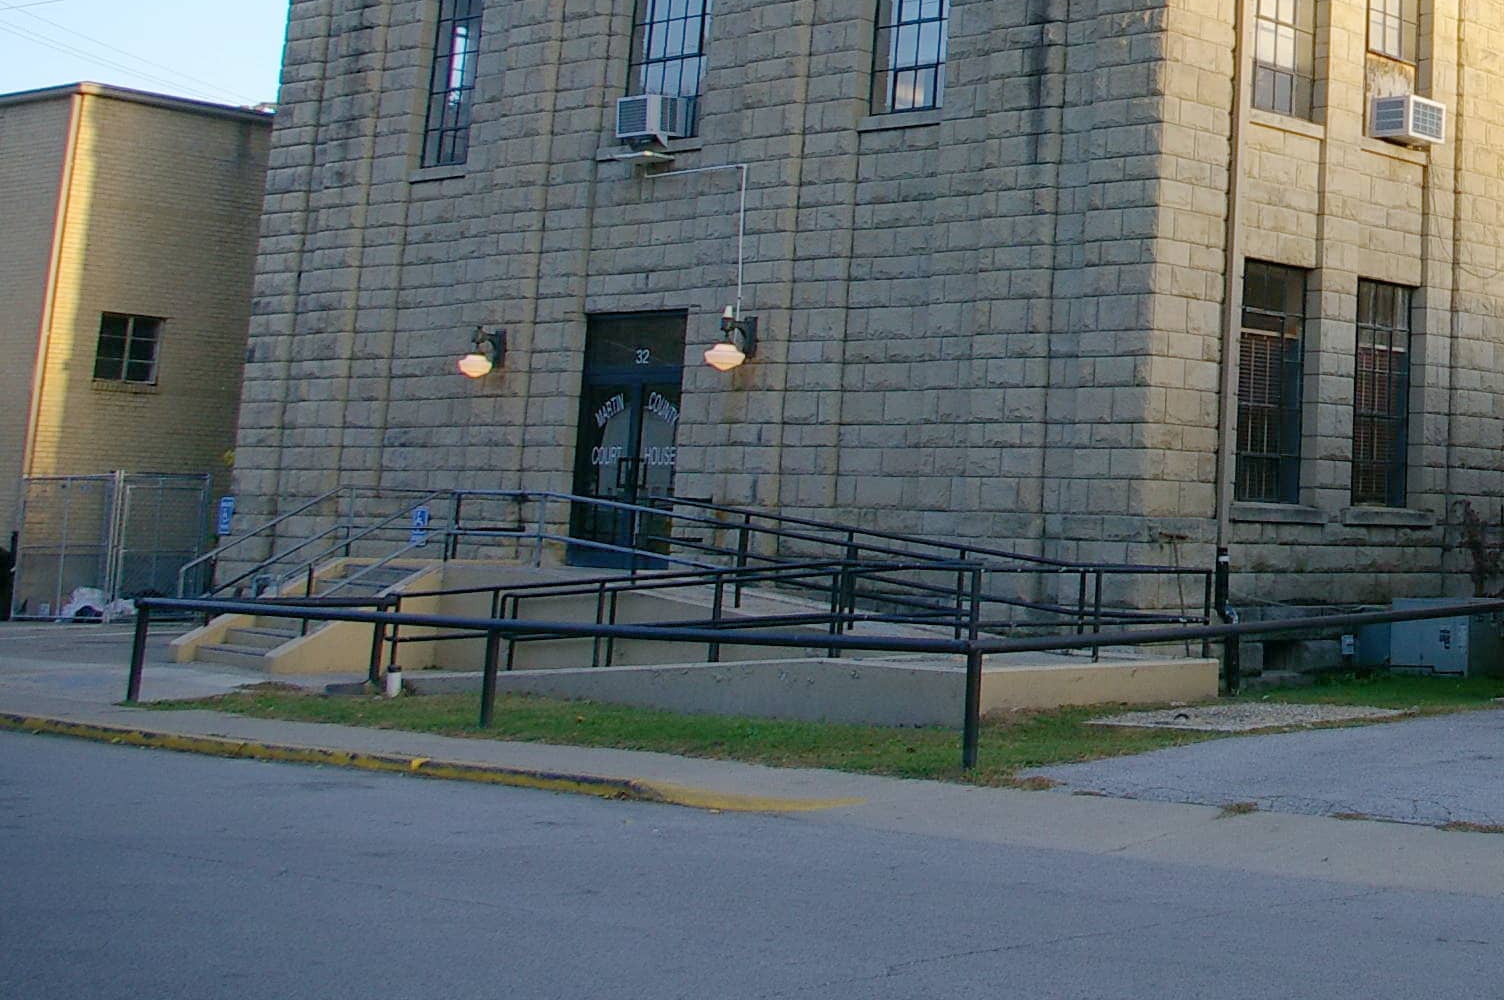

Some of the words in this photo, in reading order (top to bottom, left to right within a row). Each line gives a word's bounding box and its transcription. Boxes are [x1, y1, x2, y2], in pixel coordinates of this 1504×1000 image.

[636, 349, 650, 364] 32
[595, 392, 624, 428] MARTIN
[648, 391, 680, 425] COUNTY
[591, 446, 623, 465] COURT
[644, 446, 677, 465] HOUSE
